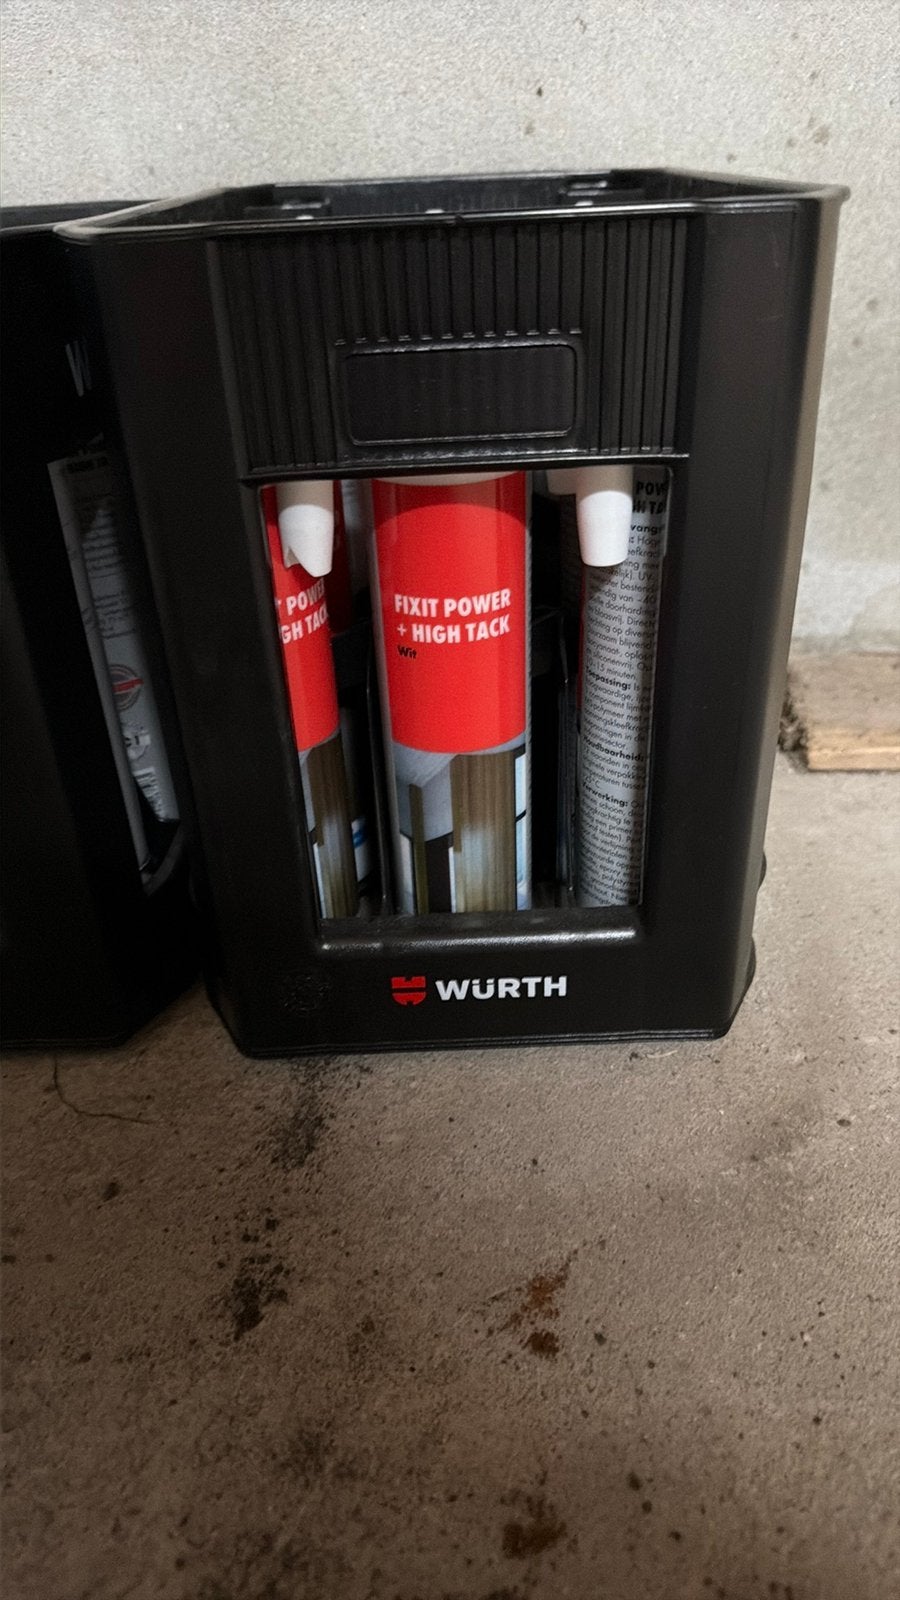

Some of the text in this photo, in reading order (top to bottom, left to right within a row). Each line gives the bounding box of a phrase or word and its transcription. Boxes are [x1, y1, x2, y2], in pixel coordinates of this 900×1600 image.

[394, 587, 511, 618] FIXIT POWER
[397, 613, 510, 644] + HIGH TACK
[612, 621, 623, 637] op
[397, 645, 418, 659] Wit
[435, 975, 567, 1001] WÜRTH
